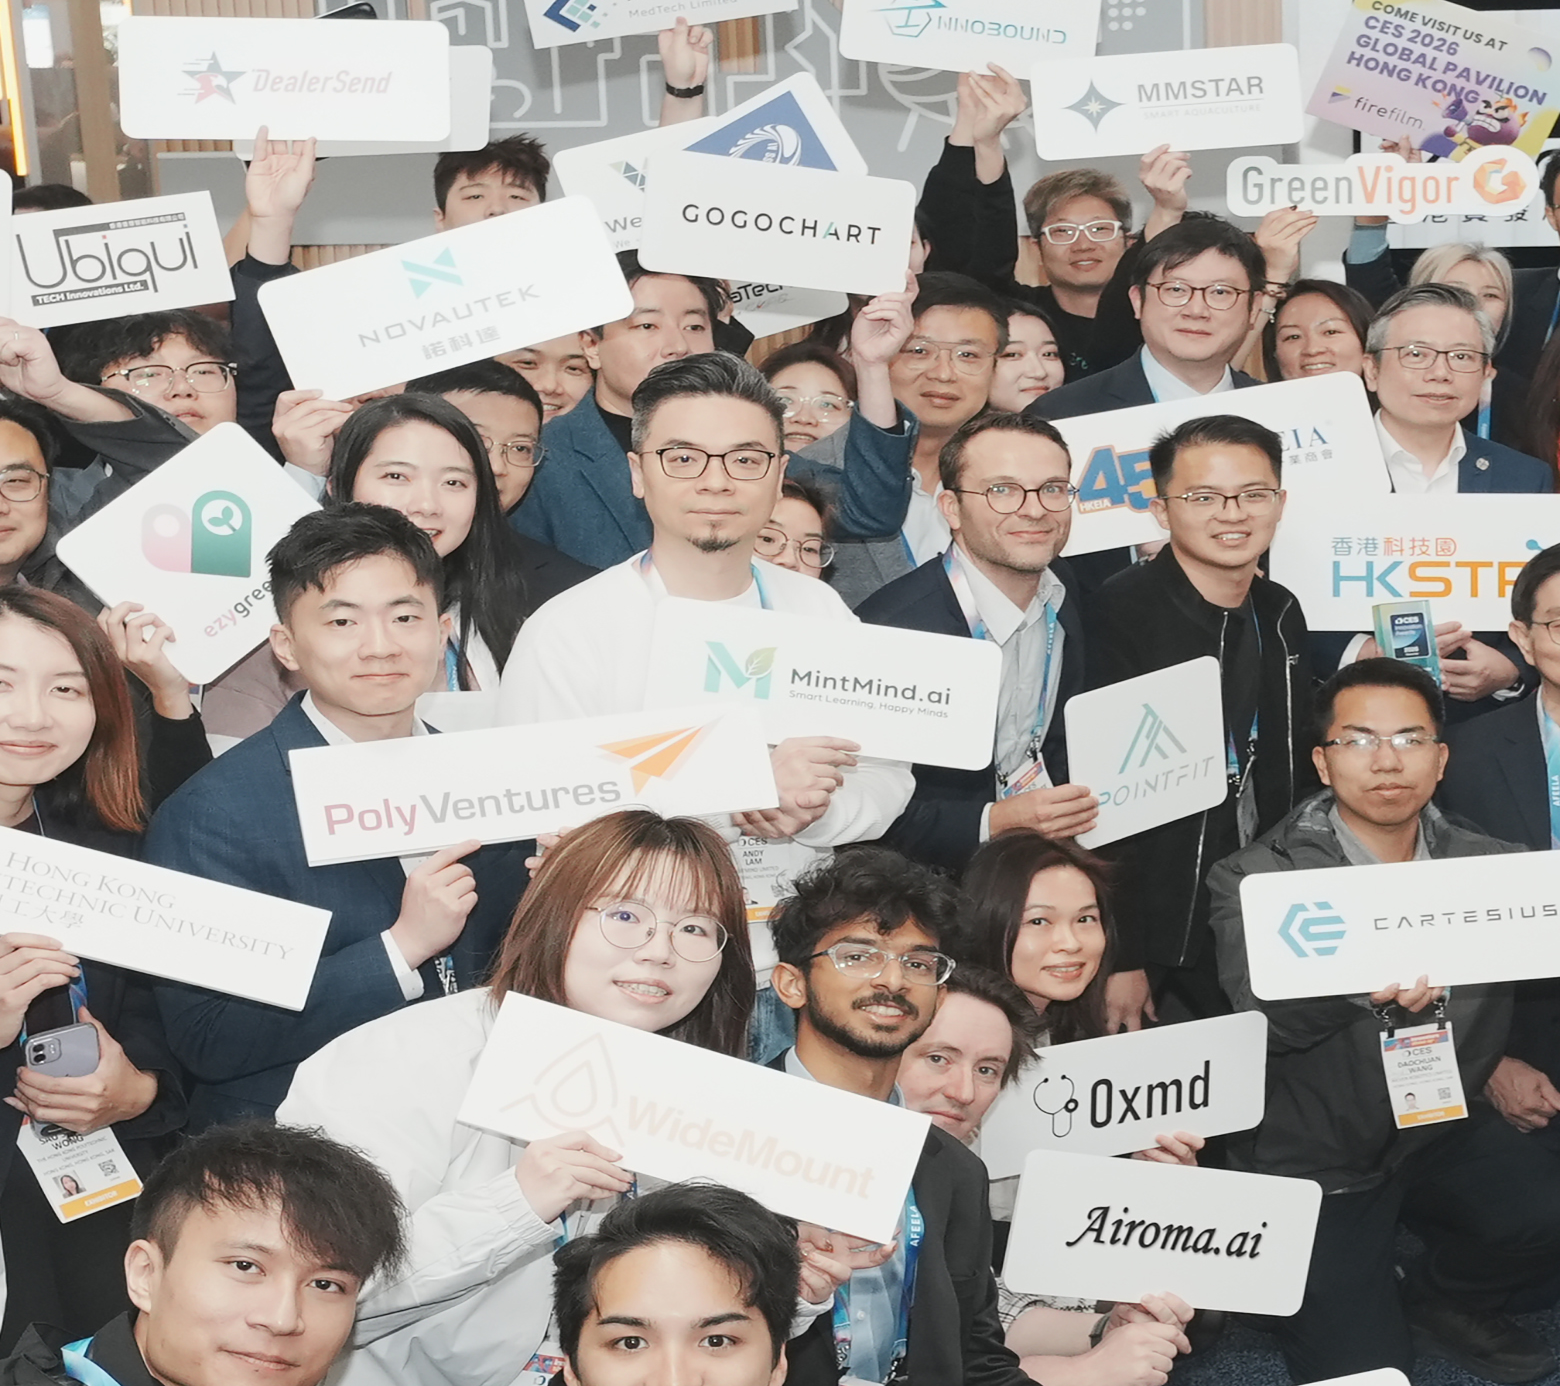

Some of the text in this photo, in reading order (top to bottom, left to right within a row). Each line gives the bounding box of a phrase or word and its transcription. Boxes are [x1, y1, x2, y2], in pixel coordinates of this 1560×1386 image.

[628, 2, 686, 19] MedTech
[1371, 0, 1508, 52] COME VISIT US AT
[1364, 15, 1459, 56] CES 2026
[251, 68, 393, 96] DealerSend
[1138, 74, 1265, 104] MMSTAR
[1345, 50, 1481, 105] HONG KONG
[1355, 33, 1548, 107] GLOBAL PAVILION
[1143, 109, 1180, 121] SMART
[1242, 159, 1460, 215] GreenVigor
[682, 203, 882, 246] GOGOCHART
[36, 281, 145, 305] TECH Innovations Ltd.
[357, 283, 541, 349] NOVAUTEK
[421, 325, 502, 361] 諾科達
[1331, 536, 1458, 557] 香港科技園
[788, 689, 949, 719] Smart Learning, Happy Minds
[789, 667, 952, 706] MintMind.ai
[324, 780, 622, 836] PolyVentures
[2, 851, 175, 912] HONG KONG
[132, 903, 296, 962] UNIVERSITY
[1373, 903, 1559, 931] CARTESIUS
[625, 1091, 877, 1202] WideMount
[1065, 1205, 1268, 1261] Airoma.ai
